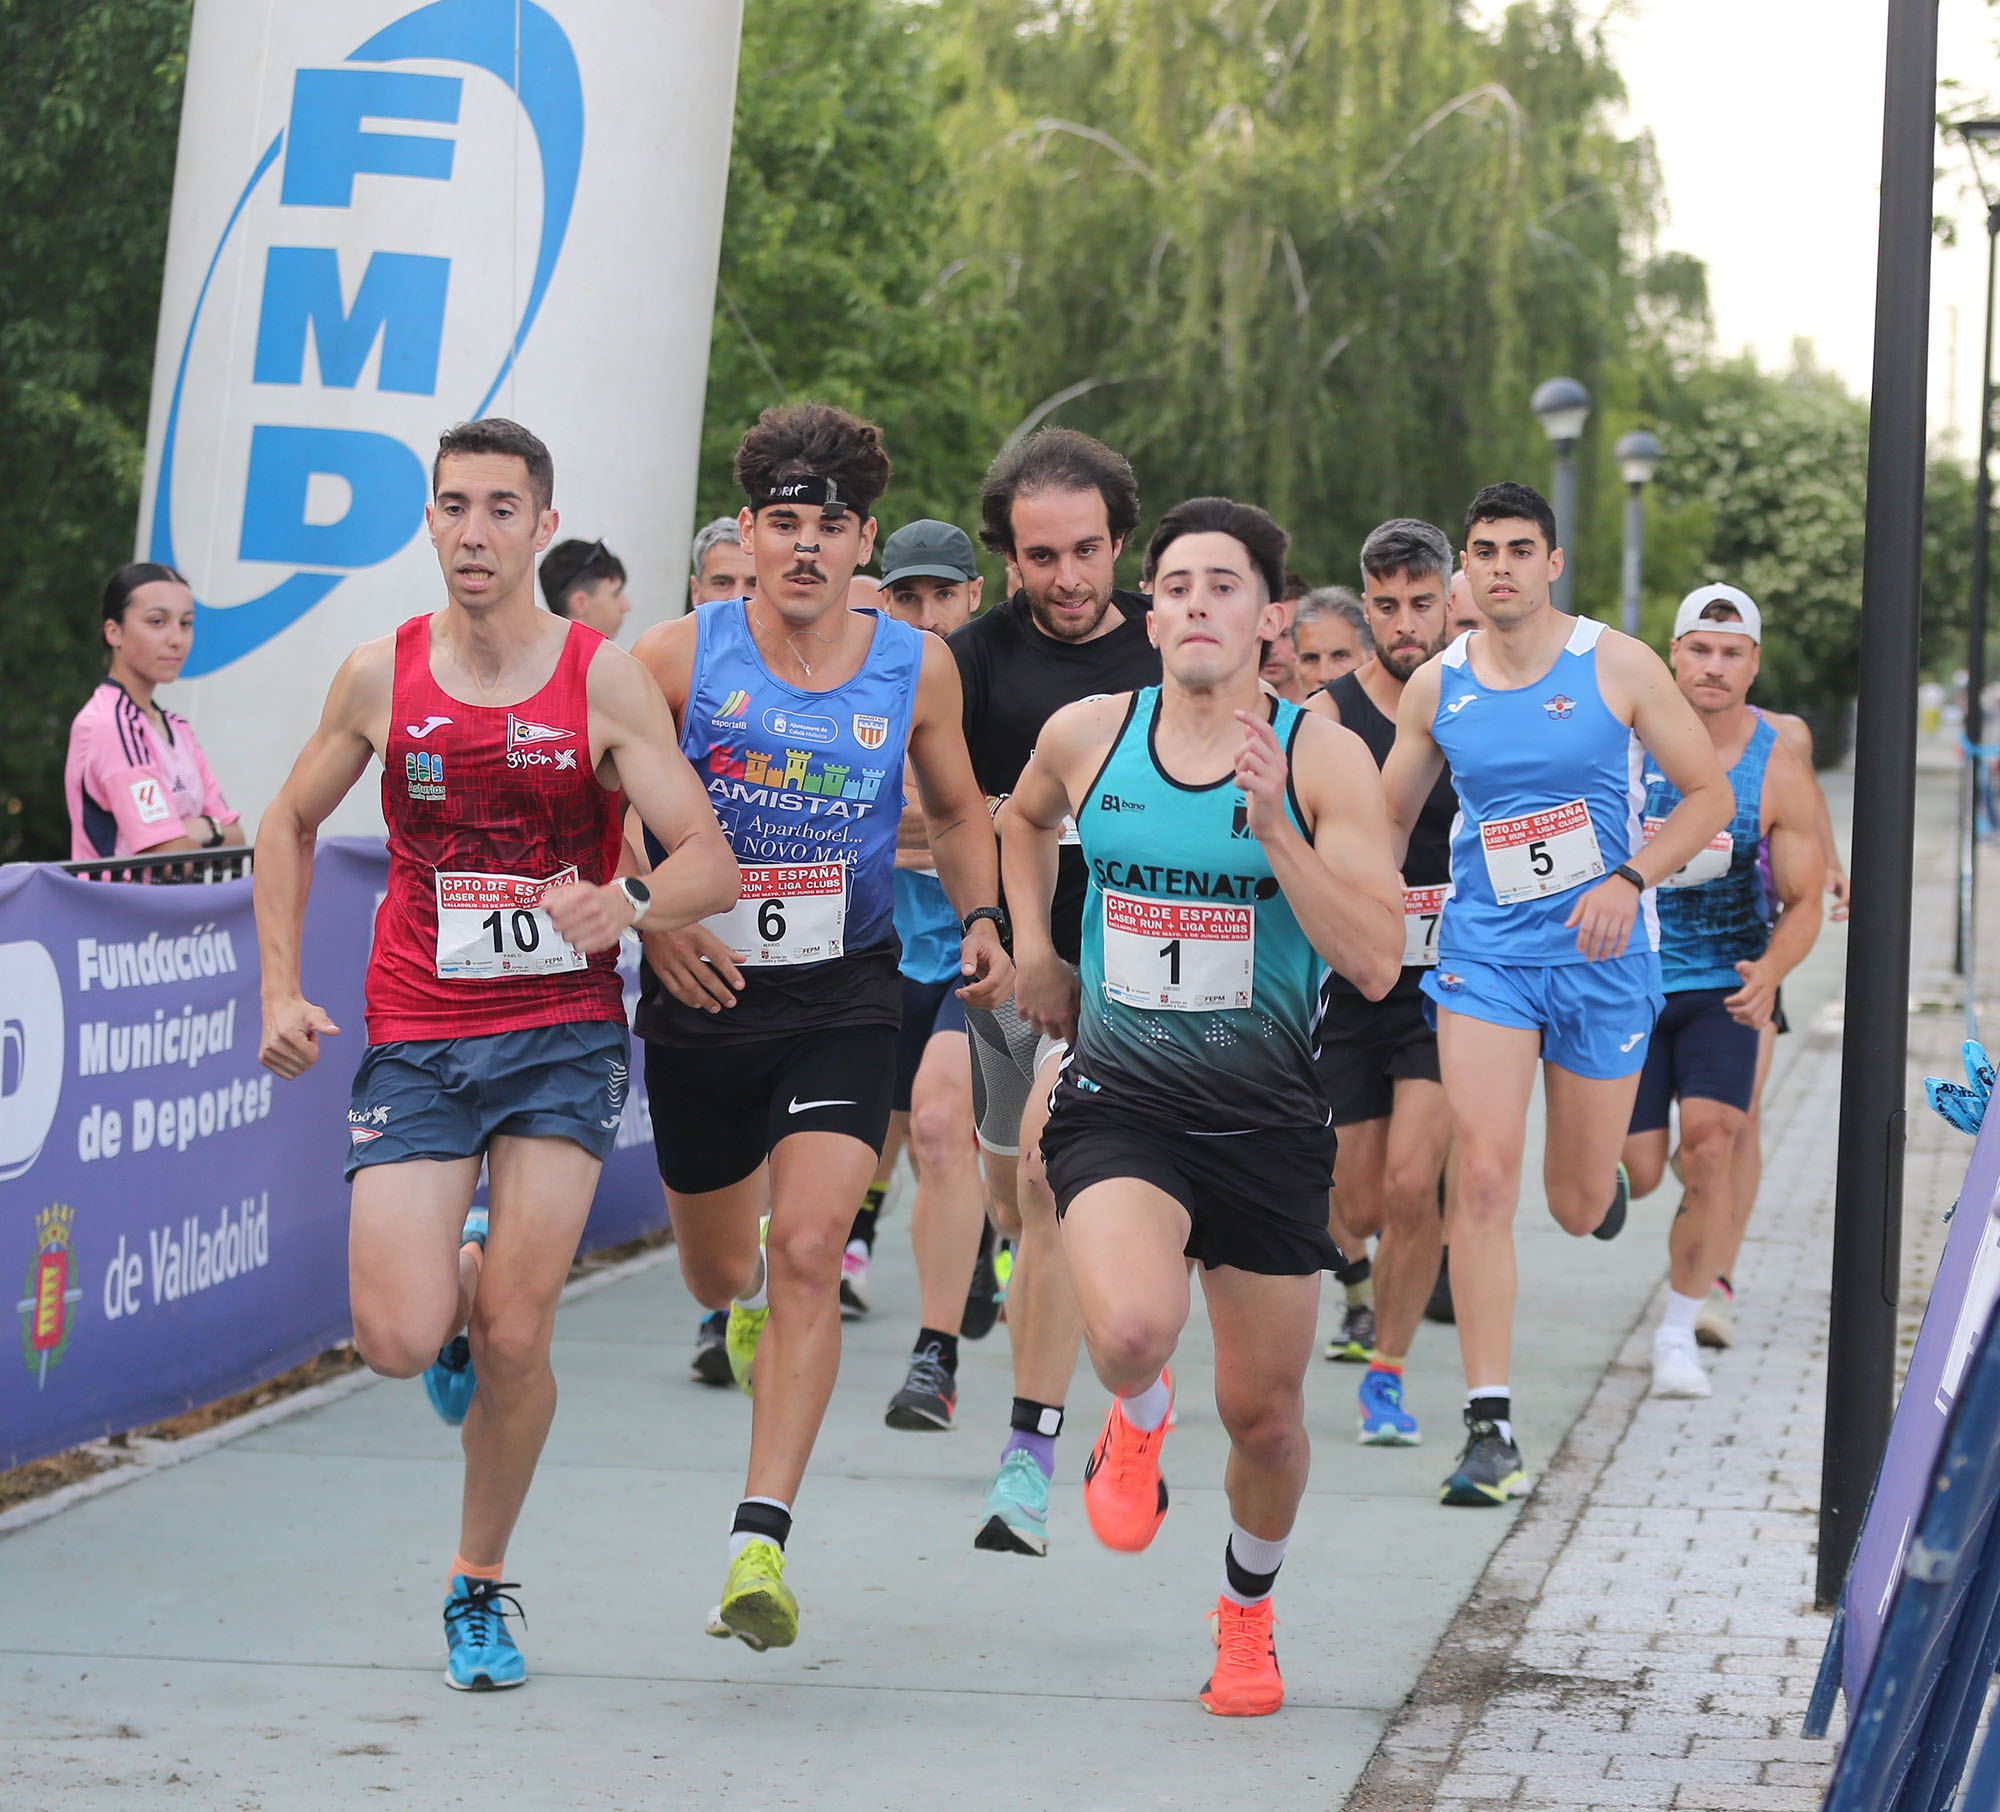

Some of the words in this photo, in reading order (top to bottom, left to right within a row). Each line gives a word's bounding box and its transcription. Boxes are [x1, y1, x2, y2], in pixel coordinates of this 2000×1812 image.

[711, 719, 747, 731] esportsIB
[789, 722, 820, 733] Ajuntament
[506, 749, 552, 769] gijón
[408, 781, 446, 795] Asturias
[708, 778, 873, 819] AMISTAT
[1122, 800, 1145, 811] bana
[1534, 804, 1583, 826] ESPAÑA
[1509, 832, 1526, 840] RUN
[1537, 825, 1556, 834] LIGA
[742, 836, 807, 860] NOVO
[812, 846, 859, 866] MAR
[1529, 841, 1553, 876] 5
[778, 865, 840, 880] ESPAÑA
[515, 874, 573, 897] ESPAÑA
[778, 882, 801, 890] LIGA
[806, 879, 840, 888] CLUBS
[443, 893, 475, 902] LASER
[479, 893, 500, 902] RUN
[514, 895, 537, 904] LIGA
[758, 899, 786, 941] 6
[1108, 911, 1136, 926] LASER
[1140, 918, 1163, 930] RUN
[1179, 924, 1205, 932] LIGA
[1210, 923, 1248, 933] CLUBS
[1180, 908, 1248, 923] ESPAÑA
[482, 909, 540, 953] 10
[1420, 913, 1440, 946] 7
[77, 922, 238, 992] Fundación
[545, 956, 564, 965] FEPM
[802, 946, 820, 954] FEPM
[1160, 940, 1181, 985] 1
[78, 999, 237, 1077] Municipal
[78, 1105, 122, 1162] de
[131, 1073, 273, 1152] Deportes
[103, 1233, 143, 1321] de
[149, 1190, 270, 1307] Valladolid
